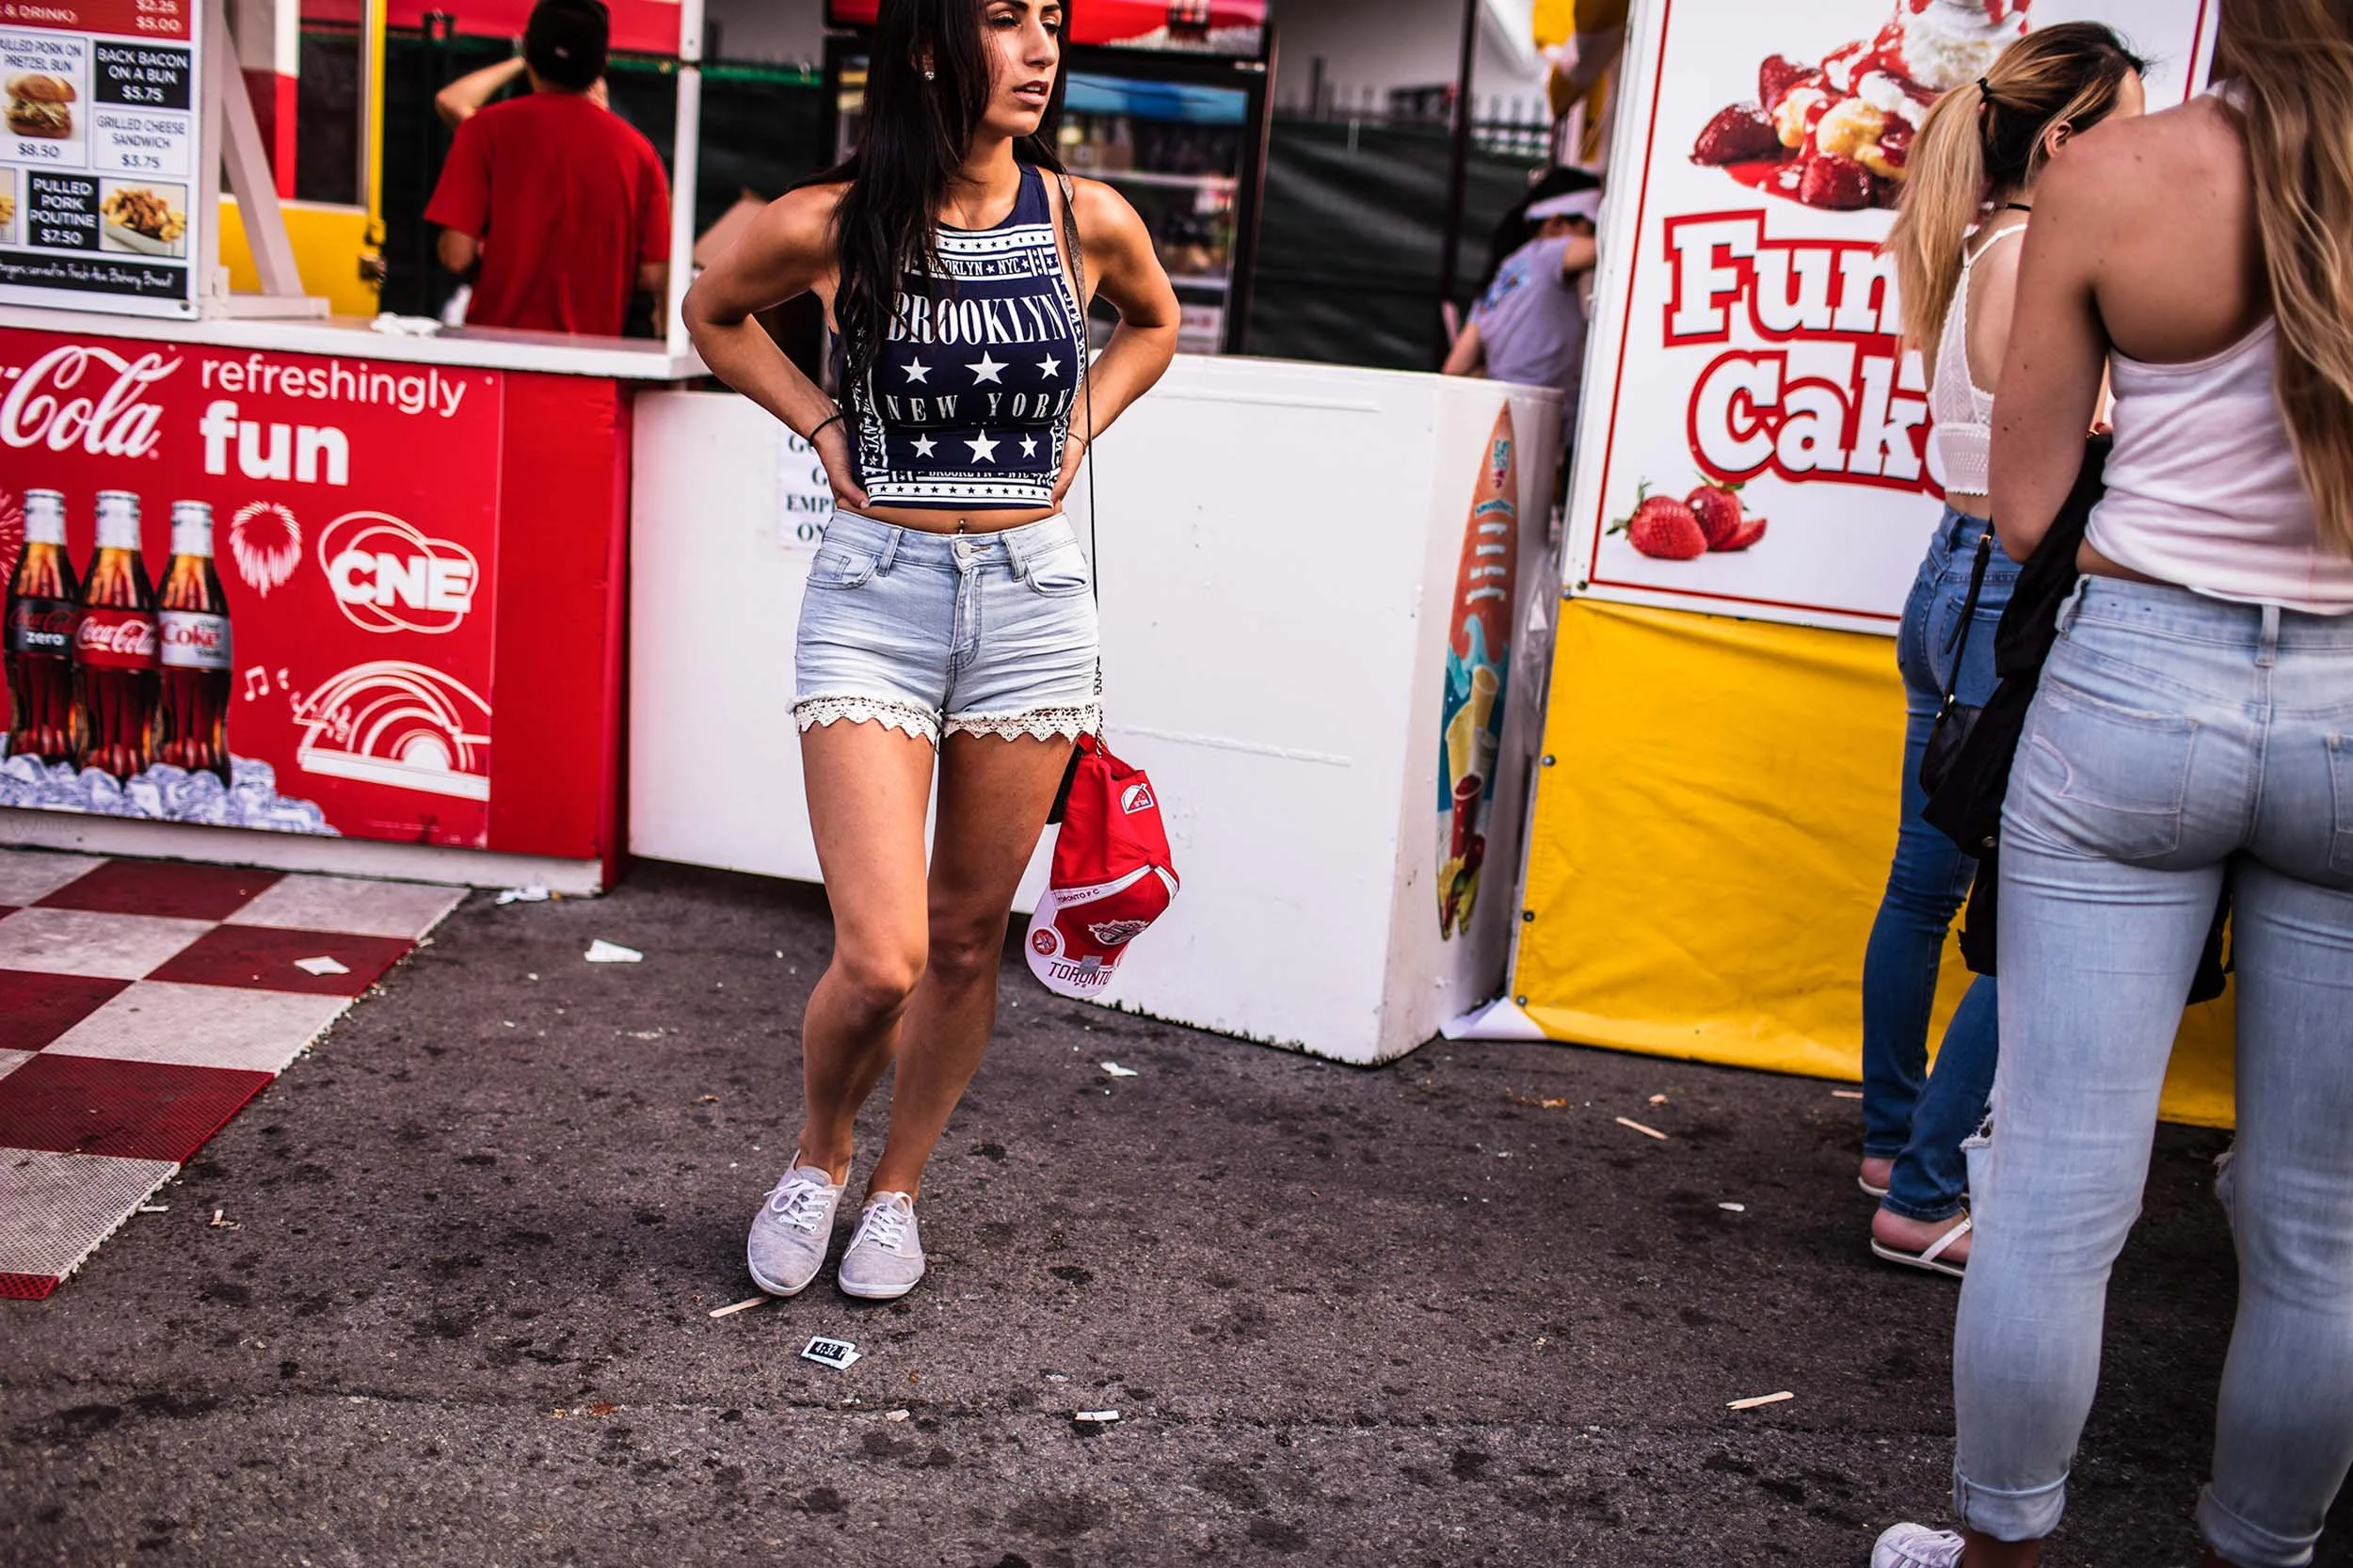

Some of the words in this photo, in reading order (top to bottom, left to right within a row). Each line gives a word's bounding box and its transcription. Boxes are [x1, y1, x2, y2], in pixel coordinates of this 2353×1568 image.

[136, 15, 182, 32] $5.00
[0, 39, 33, 53] ULLED
[66, 43, 81, 56] ON
[51, 58, 72, 72] BUN
[97, 48, 136, 65] BACK
[138, 50, 188, 69] BACON
[108, 65, 131, 80] ON
[134, 67, 145, 82] A
[147, 68, 178, 85] BUN
[121, 85, 165, 103] $5.75
[96, 116, 140, 131] GRILLED
[144, 119, 185, 135] CHEESE
[18, 143, 60, 158] $8.50
[112, 134, 170, 149] SANDWICH
[121, 153, 160, 168] $3.75
[34, 177, 93, 197] PULLED
[41, 195, 85, 212] PORK
[30, 210, 97, 229] POUTINE
[41, 228, 83, 246] $7.50
[997, 257, 1020, 275] NYC
[886, 291, 1067, 345] BROOKLYN
[201, 354, 467, 417] refreshingly
[886, 394, 959, 423] NEW
[987, 388, 1071, 420] YORK
[199, 400, 350, 486] fun
[862, 424, 881, 454] NYC
[329, 548, 472, 614] CNE
[25, 631, 65, 648] zero
[161, 619, 220, 648] Coke
[815, 1343, 838, 1355] 4:32
